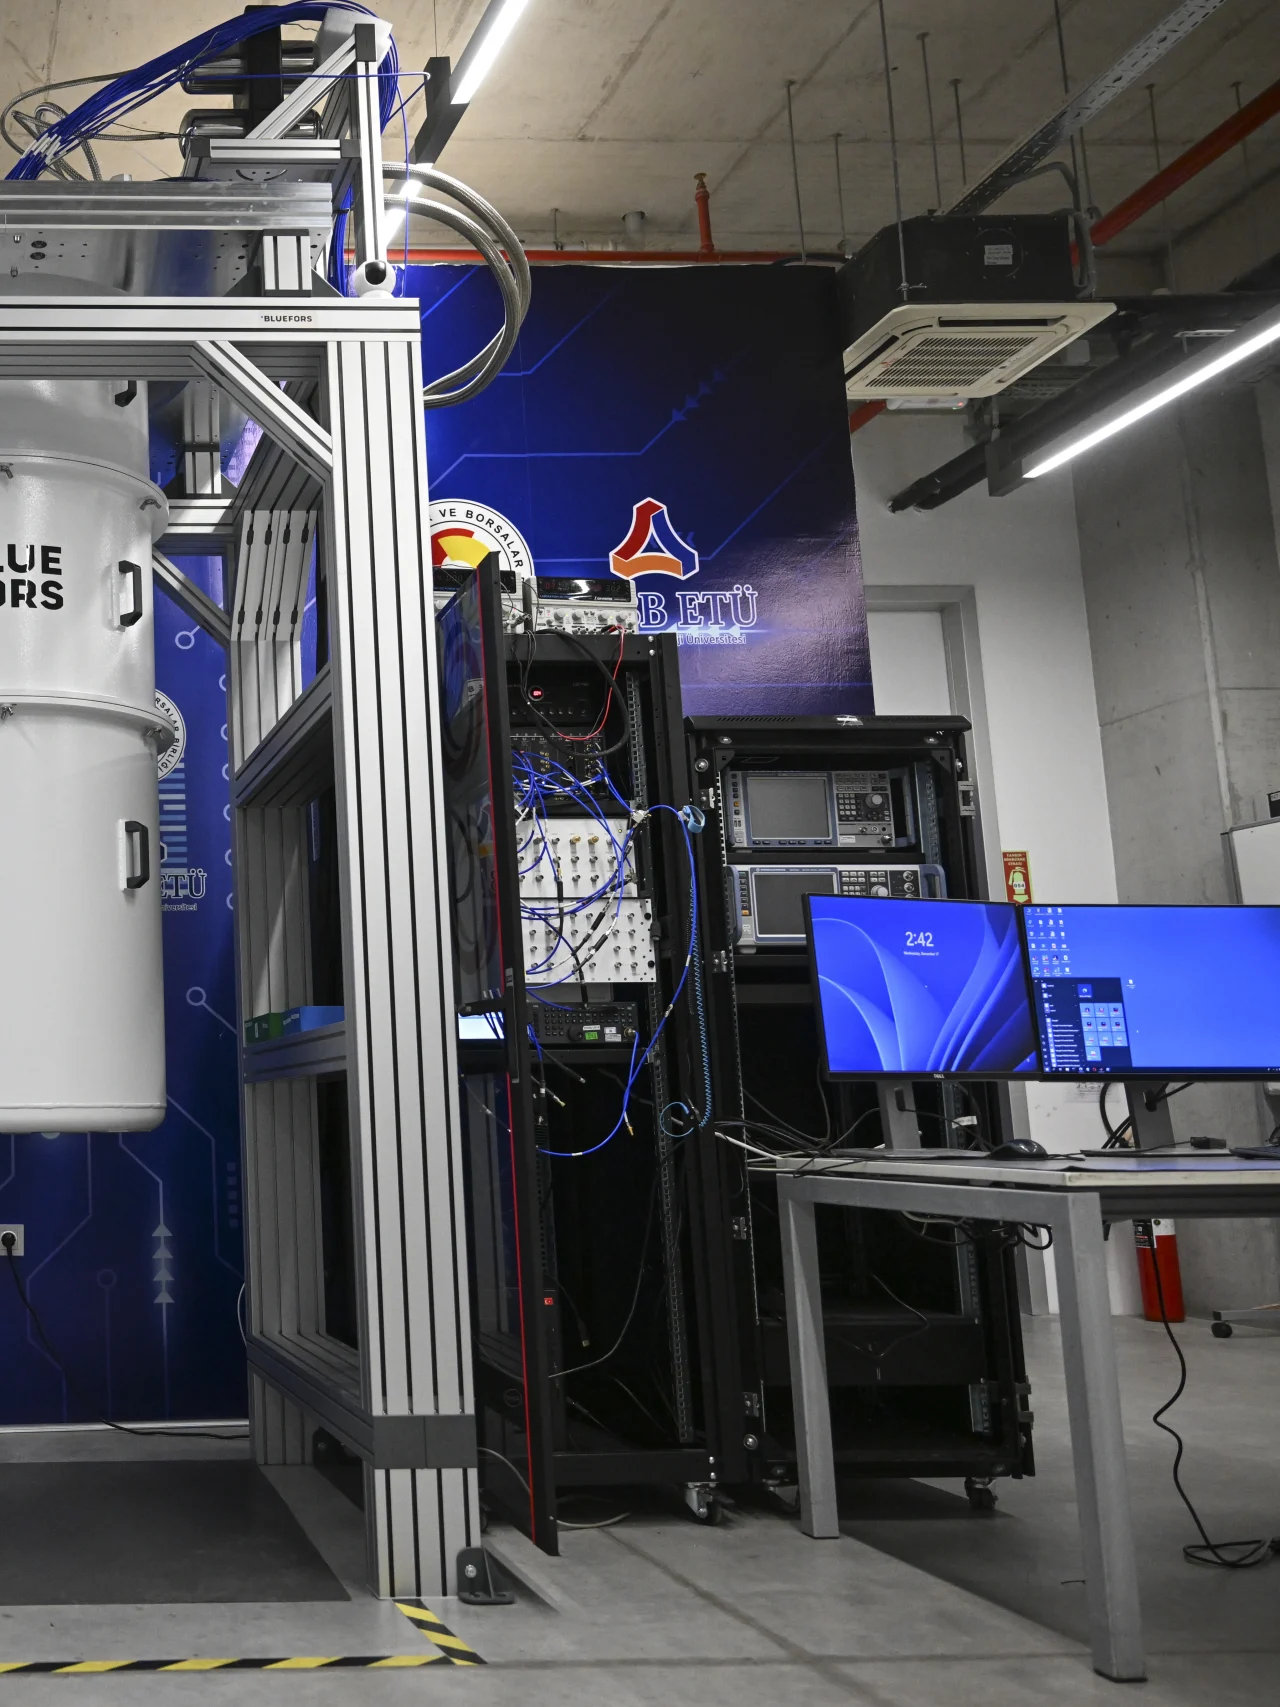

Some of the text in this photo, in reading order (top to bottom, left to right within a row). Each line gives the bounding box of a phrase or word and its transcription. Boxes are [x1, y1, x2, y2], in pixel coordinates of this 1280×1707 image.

[439, 508, 524, 568] VE BORSALAR
[637, 584, 758, 627] B ETÜ
[686, 632, 747, 646] Üniversitesi
[905, 931, 935, 947] 2:42
